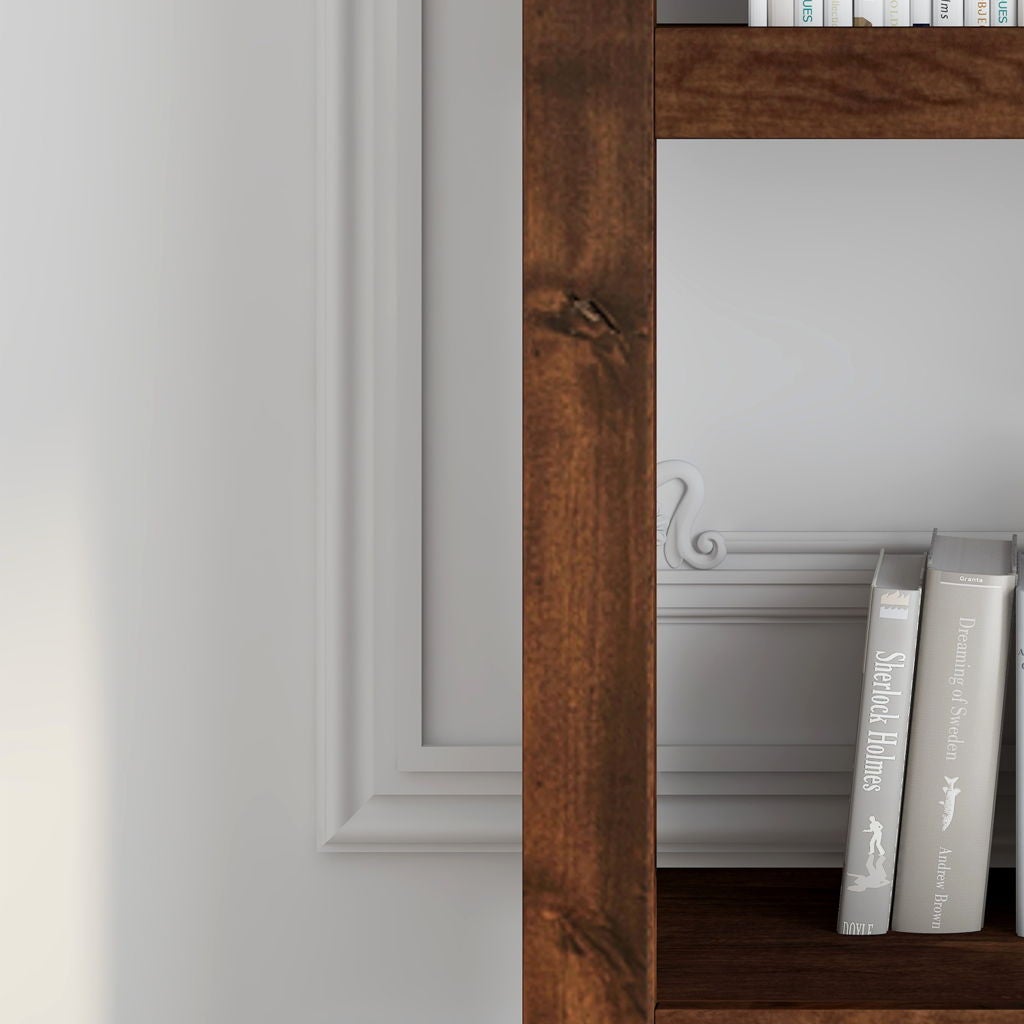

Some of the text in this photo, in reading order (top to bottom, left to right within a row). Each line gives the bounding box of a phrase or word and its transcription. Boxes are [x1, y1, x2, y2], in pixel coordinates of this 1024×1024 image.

[862, 650, 906, 792] Sherlock Holmes
[946, 617, 976, 760] Dreaming of Sweden
[932, 846, 952, 928] Andrew Brown
